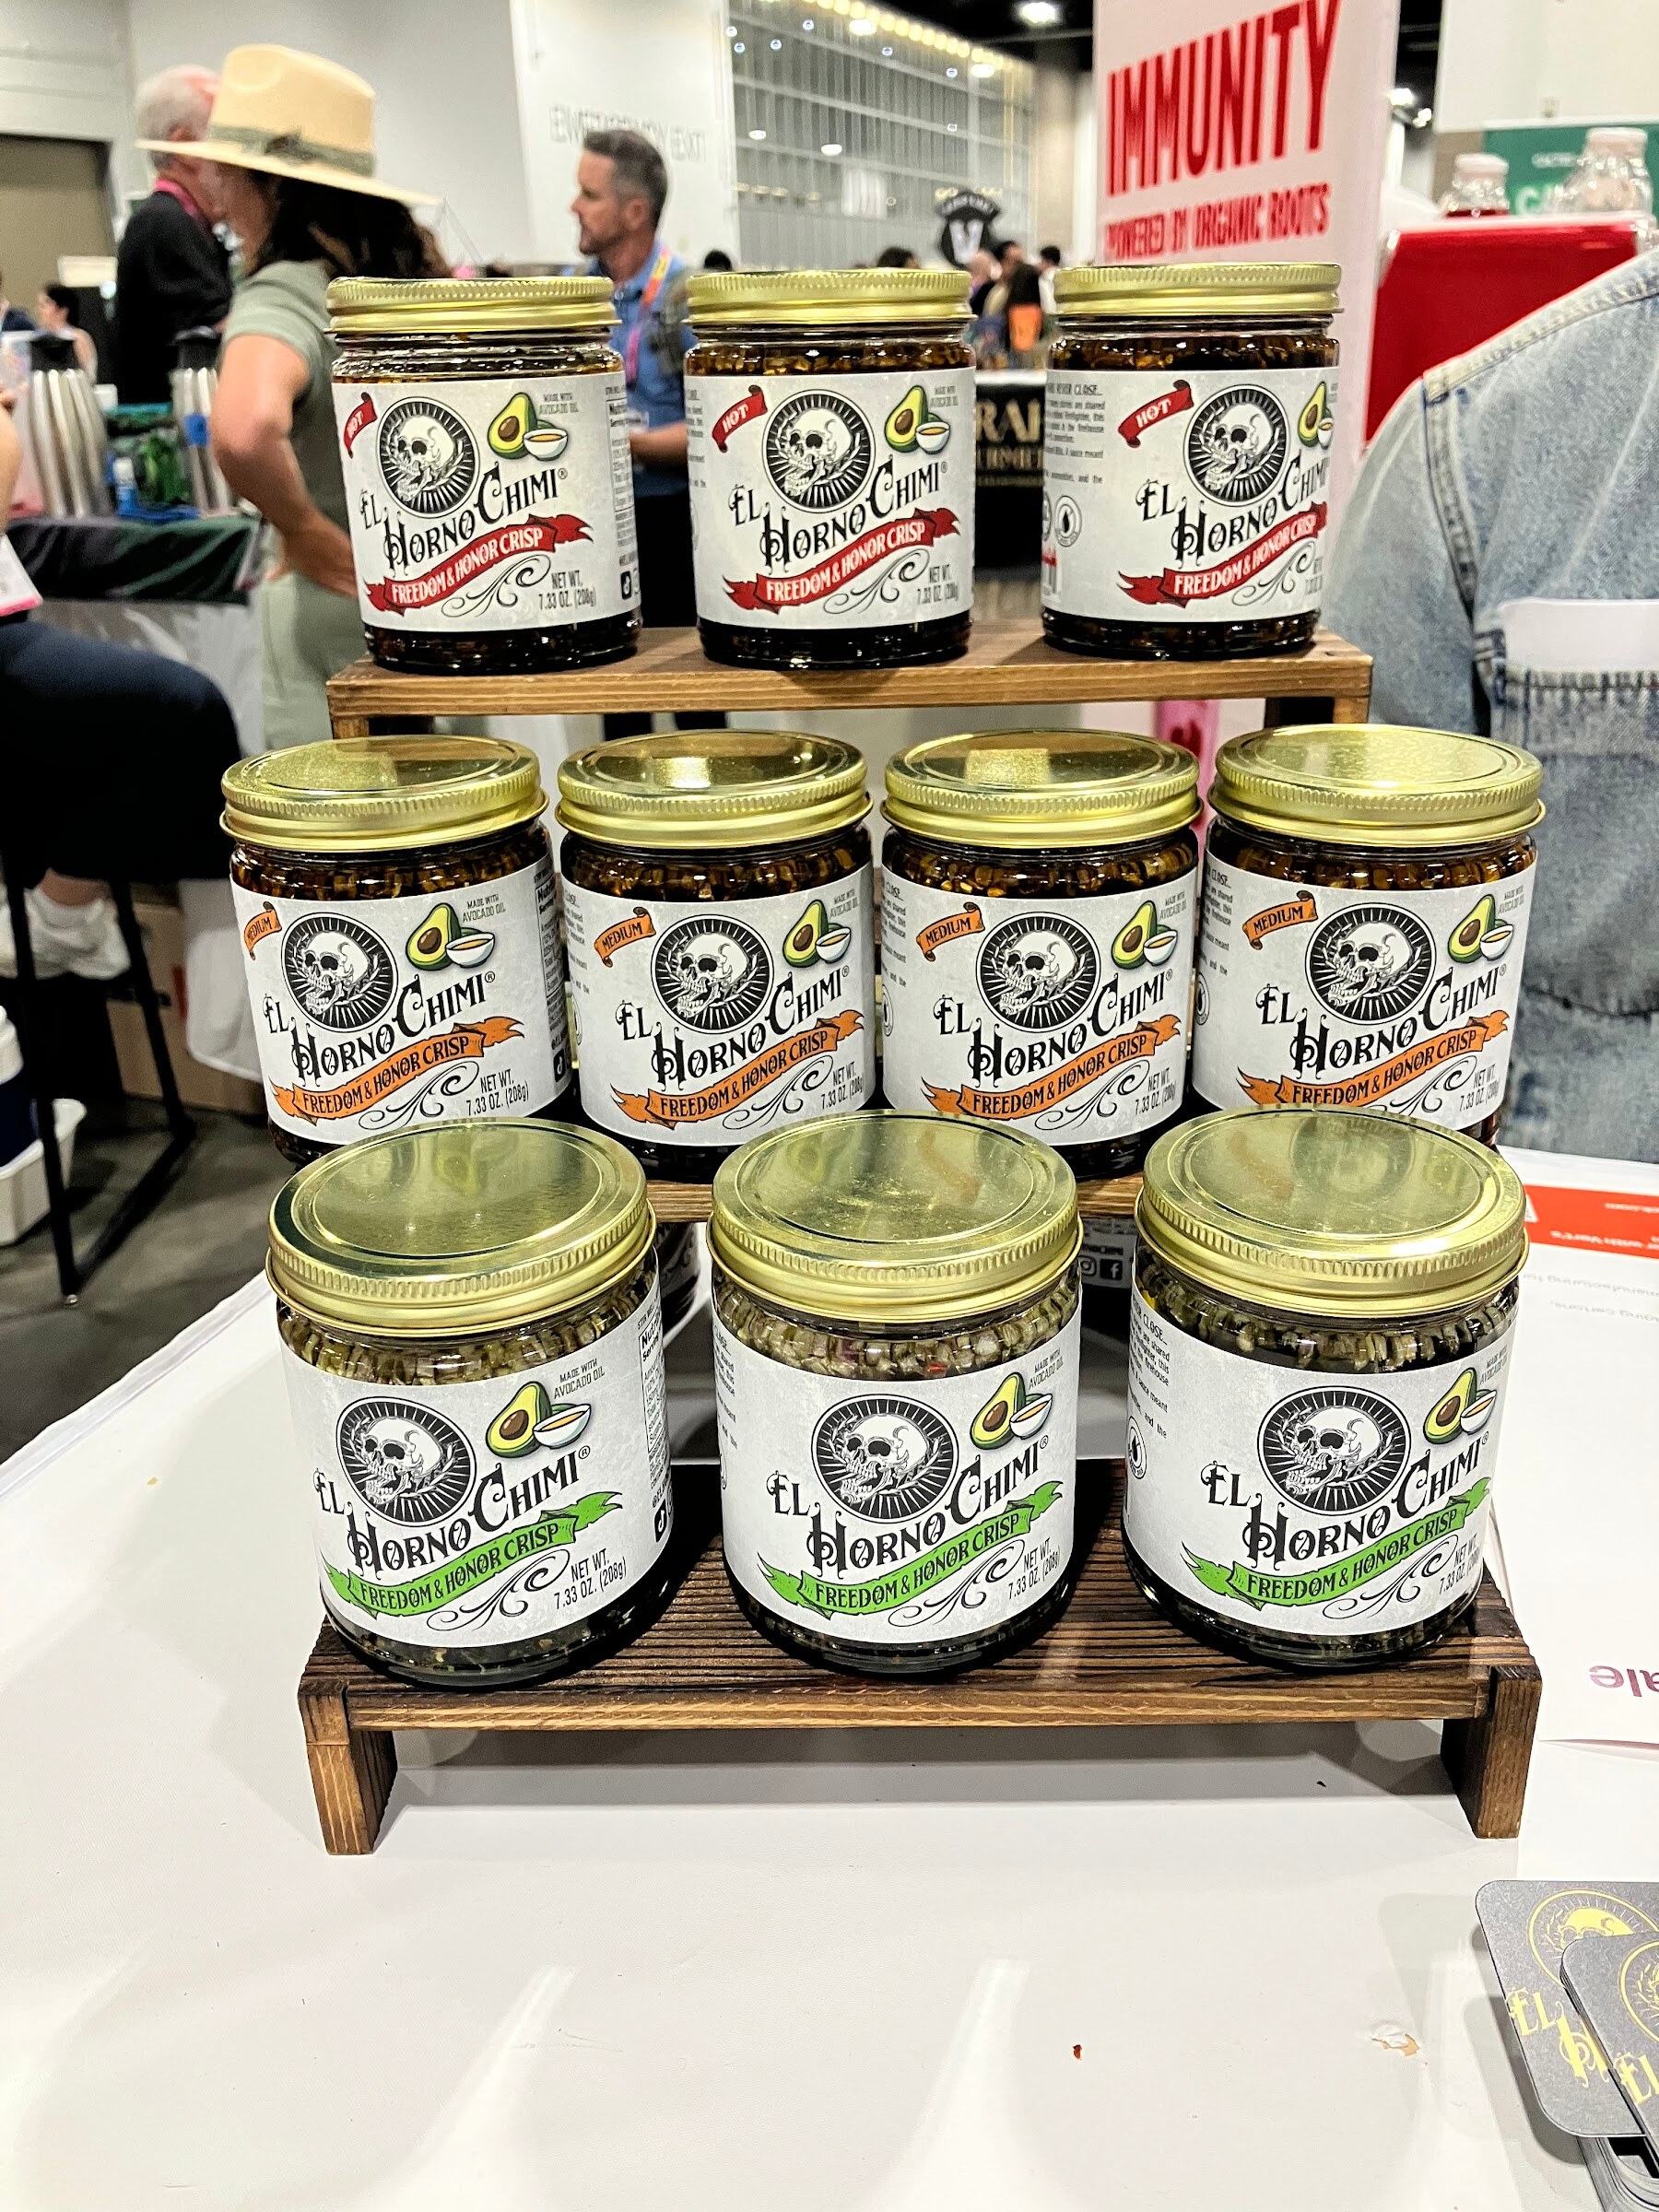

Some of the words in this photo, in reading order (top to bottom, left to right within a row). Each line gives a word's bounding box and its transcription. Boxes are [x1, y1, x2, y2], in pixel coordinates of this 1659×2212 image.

[1108, 0, 1339, 197] IMMUNITY
[1172, 207, 1188, 253] BY
[1194, 194, 1262, 251] ORGANIC
[1268, 183, 1329, 240] ROOTS
[347, 410, 364, 435] HOT
[722, 405, 749, 432] HOT
[1135, 398, 1171, 428] HOT
[359, 488, 382, 530] EL
[382, 507, 477, 577] HORNO
[728, 484, 761, 526] EL
[759, 502, 866, 575] HORNO
[1135, 478, 1176, 521] EL
[1171, 497, 1277, 569] HORNO
[392, 574, 447, 605] FREEDOM
[446, 570, 455, 586] &
[454, 539, 498, 581] HONOR
[499, 526, 544, 554] CRISP
[766, 574, 831, 602] FREEDOM
[831, 567, 841, 584] &
[841, 537, 887, 578] HONOR
[887, 522, 925, 551] CRISP
[1174, 569, 1242, 596] FREEDOM
[1242, 560, 1252, 578] &
[1251, 531, 1291, 571] HONOR
[463, 906, 495, 923] AVOCADO
[601, 921, 643, 952] MEDIUM
[925, 917, 972, 947] MEDIUM
[1253, 905, 1304, 934] MEDIUM
[264, 993, 290, 1035] EL
[290, 1017, 396, 1088] HORNO
[615, 999, 654, 1041] EL
[651, 1021, 767, 1092] HORNO
[933, 994, 972, 1036] EL
[967, 1017, 1087, 1088] HORNO
[1256, 983, 1298, 1026] EL
[1289, 1008, 1418, 1080] HORNO
[302, 1086, 364, 1113] FREEDOM
[364, 1080, 373, 1100] &
[373, 1050, 422, 1092] HONOR
[422, 1036, 471, 1066] CRISP
[480, 1074, 497, 1094] NET
[660, 1088, 731, 1118] FREEDOM
[731, 1082, 741, 1100] &
[740, 1049, 788, 1093] HONOR
[788, 1030, 829, 1062] CRISP
[820, 1090, 838, 1111] 7.33
[832, 1069, 846, 1088] NET
[972, 1087, 1045, 1115] FREEDOM
[1046, 1081, 1055, 1100] &
[1057, 1049, 1106, 1092] HONOR
[1107, 1034, 1148, 1065] CRISP
[1147, 1074, 1160, 1091] NET
[1292, 1082, 1370, 1105] FREEDOM
[1371, 1075, 1381, 1094] &
[1382, 1042, 1434, 1086] HONOR
[1435, 1029, 1477, 1058] CRISP
[466, 1097, 488, 1117] 7.33
[1135, 1095, 1151, 1115] 7.33
[554, 1372, 592, 1400] AVOCADO
[559, 1367, 580, 1383] MADE
[580, 1358, 598, 1373] WITH
[313, 1467, 346, 1514] EL
[346, 1501, 472, 1580] HORNO
[766, 1469, 812, 1515] EL
[806, 1502, 946, 1579] HORNO
[1201, 1460, 1253, 1506] EL
[1242, 1493, 1393, 1570] HORNO
[359, 1585, 433, 1610] FREEDOM
[434, 1580, 444, 1603] &
[445, 1544, 502, 1594] HONOR
[503, 1525, 560, 1561] CRISP
[554, 1585, 581, 1611] 7.33
[599, 1556, 627, 1594] (208g)
[571, 1558, 591, 1582] NET
[815, 1583, 899, 1610] FREEDOM
[900, 1575, 911, 1595] &
[912, 1542, 971, 1590] HONOR
[971, 1512, 1021, 1552] CRISP
[1008, 1577, 1028, 1602] 7.33
[1023, 1547, 1039, 1571] NET
[1246, 1575, 1336, 1601] FREEDOM
[1338, 1565, 1349, 1586] &
[1352, 1533, 1411, 1580] HONOR
[1412, 1508, 1459, 1546] CRISP
